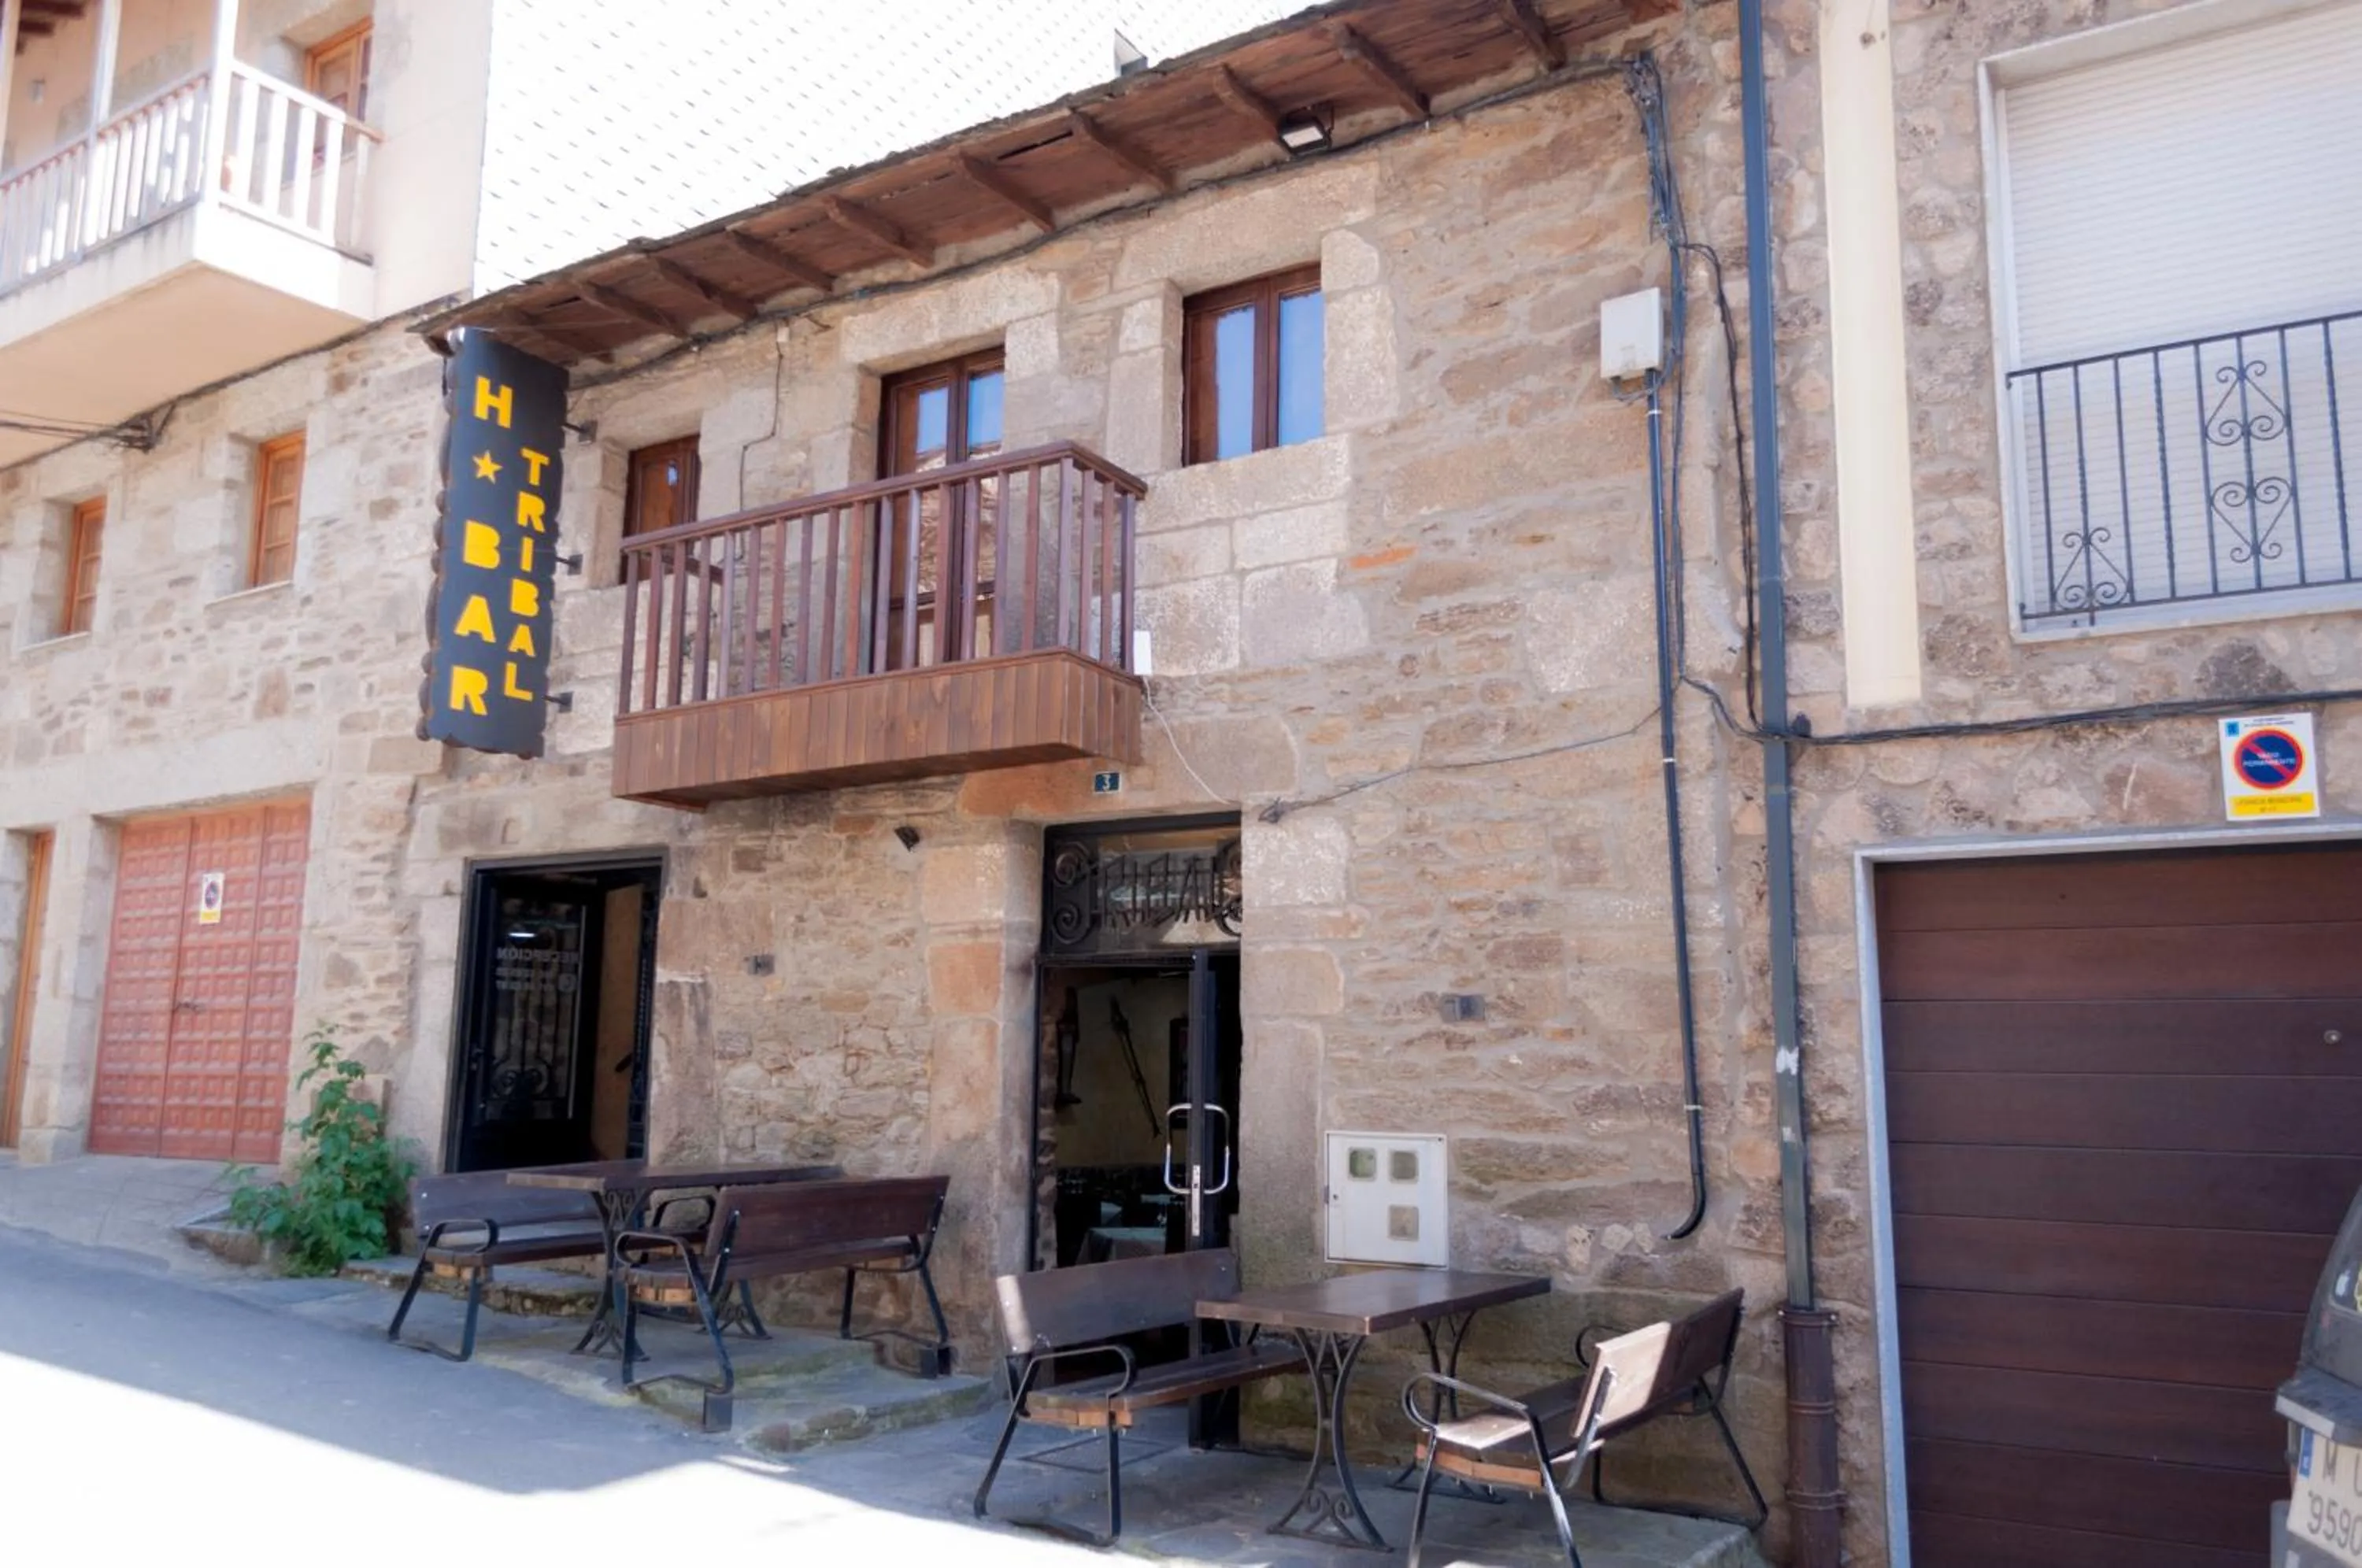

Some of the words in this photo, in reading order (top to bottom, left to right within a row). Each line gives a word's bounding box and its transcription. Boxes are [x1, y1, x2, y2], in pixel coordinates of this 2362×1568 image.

[476, 375, 513, 429] H
[504, 447, 550, 701] TRIBAL
[450, 520, 501, 716] BAR
[1102, 774, 1110, 792] 3
[2307, 1491, 2362, 1556] 9590
